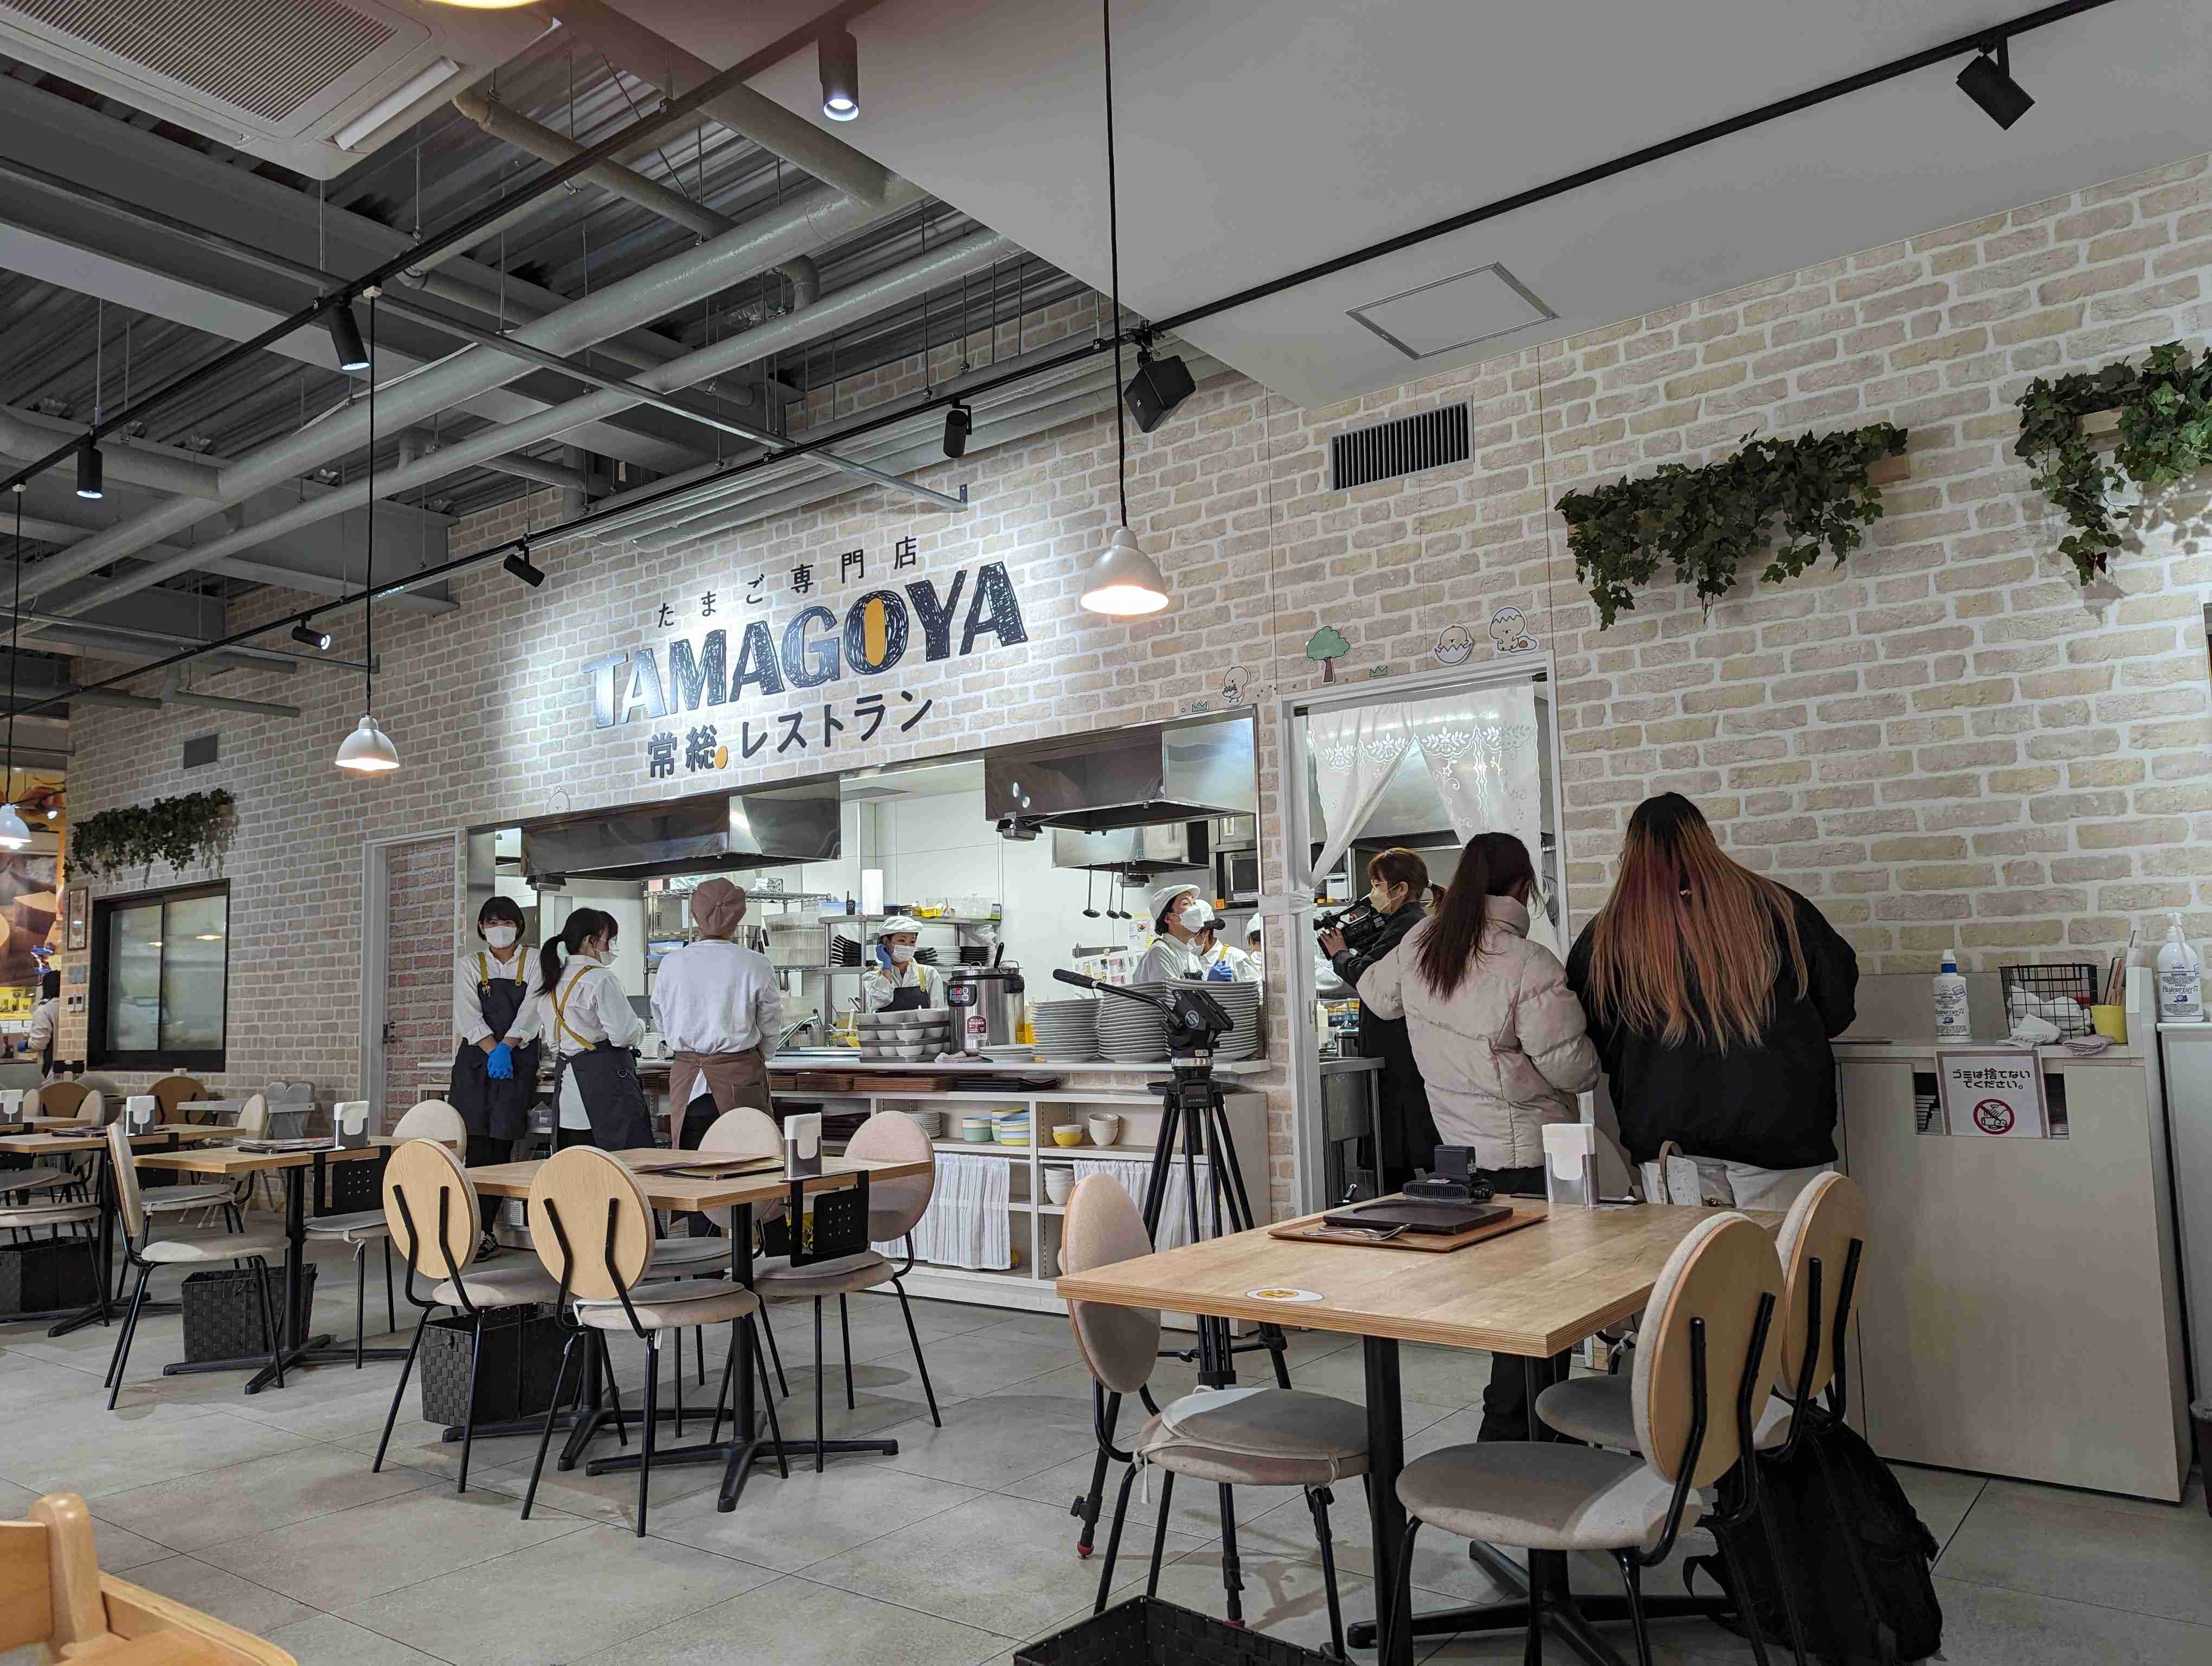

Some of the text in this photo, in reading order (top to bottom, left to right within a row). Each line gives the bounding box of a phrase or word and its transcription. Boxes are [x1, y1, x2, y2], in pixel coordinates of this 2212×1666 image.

[658, 536, 917, 628] たまご専門店
[582, 561, 1028, 728] TAMAGOYA
[1952, 1068, 2030, 1080] ゴミは捨てない
[1963, 1079, 2023, 1089] でください。
